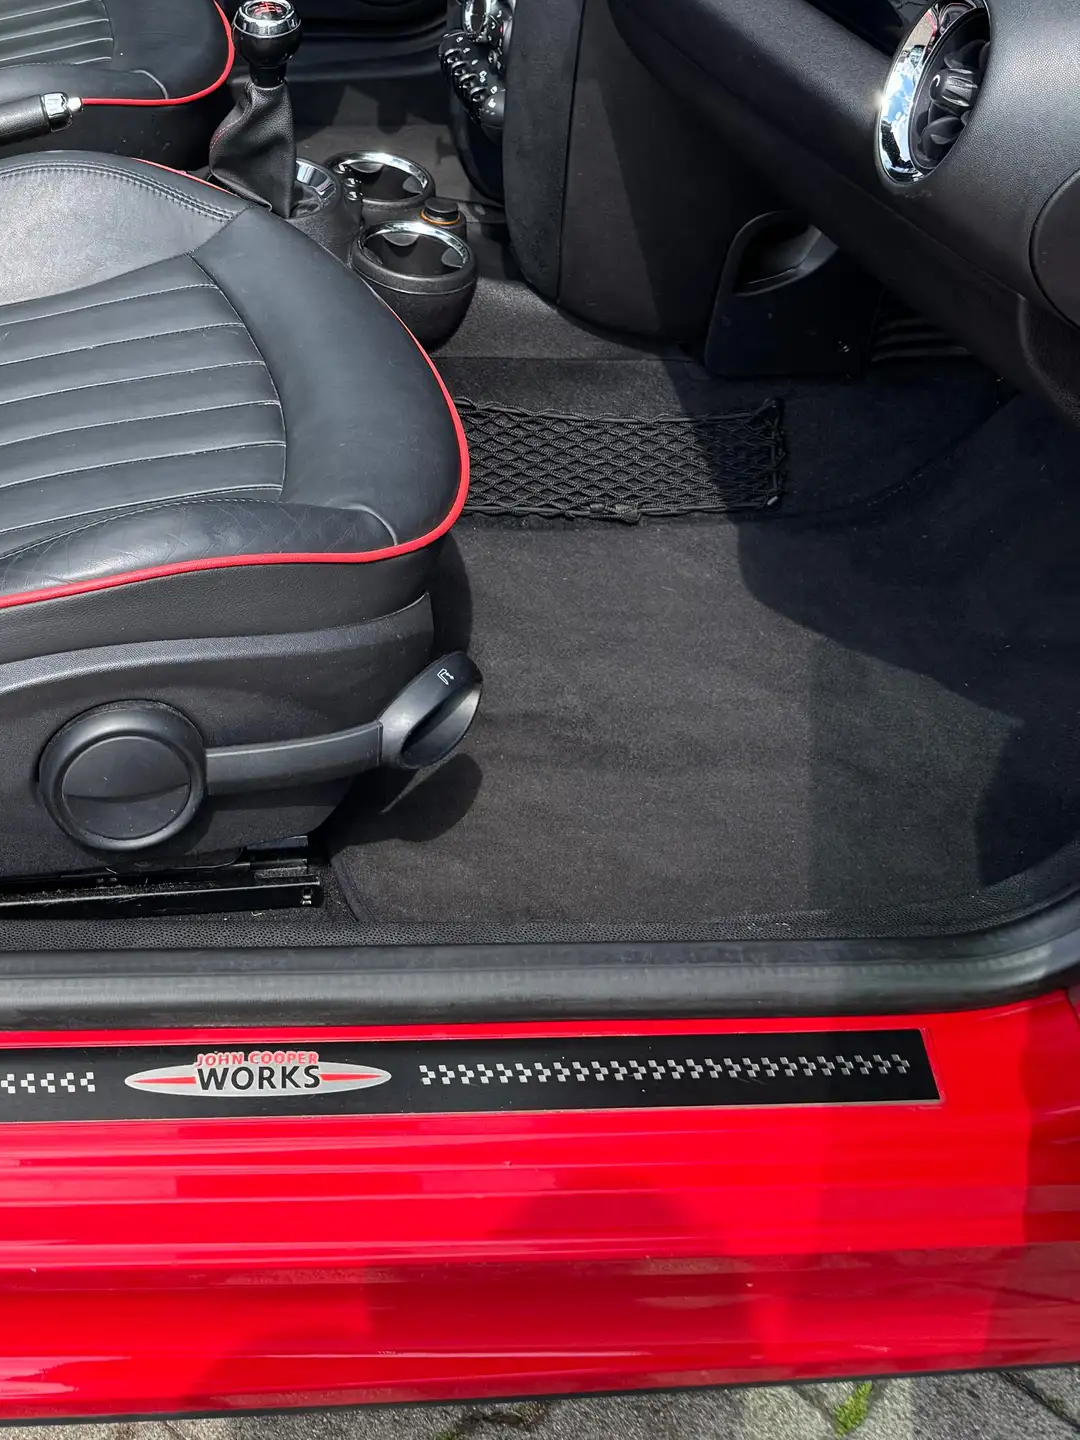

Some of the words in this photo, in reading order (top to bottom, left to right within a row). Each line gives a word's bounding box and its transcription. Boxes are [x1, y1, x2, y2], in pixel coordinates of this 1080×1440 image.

[196, 1052, 244, 1067] JOHN
[248, 1051, 320, 1065] COOPER
[197, 1065, 321, 1091] WORKS
